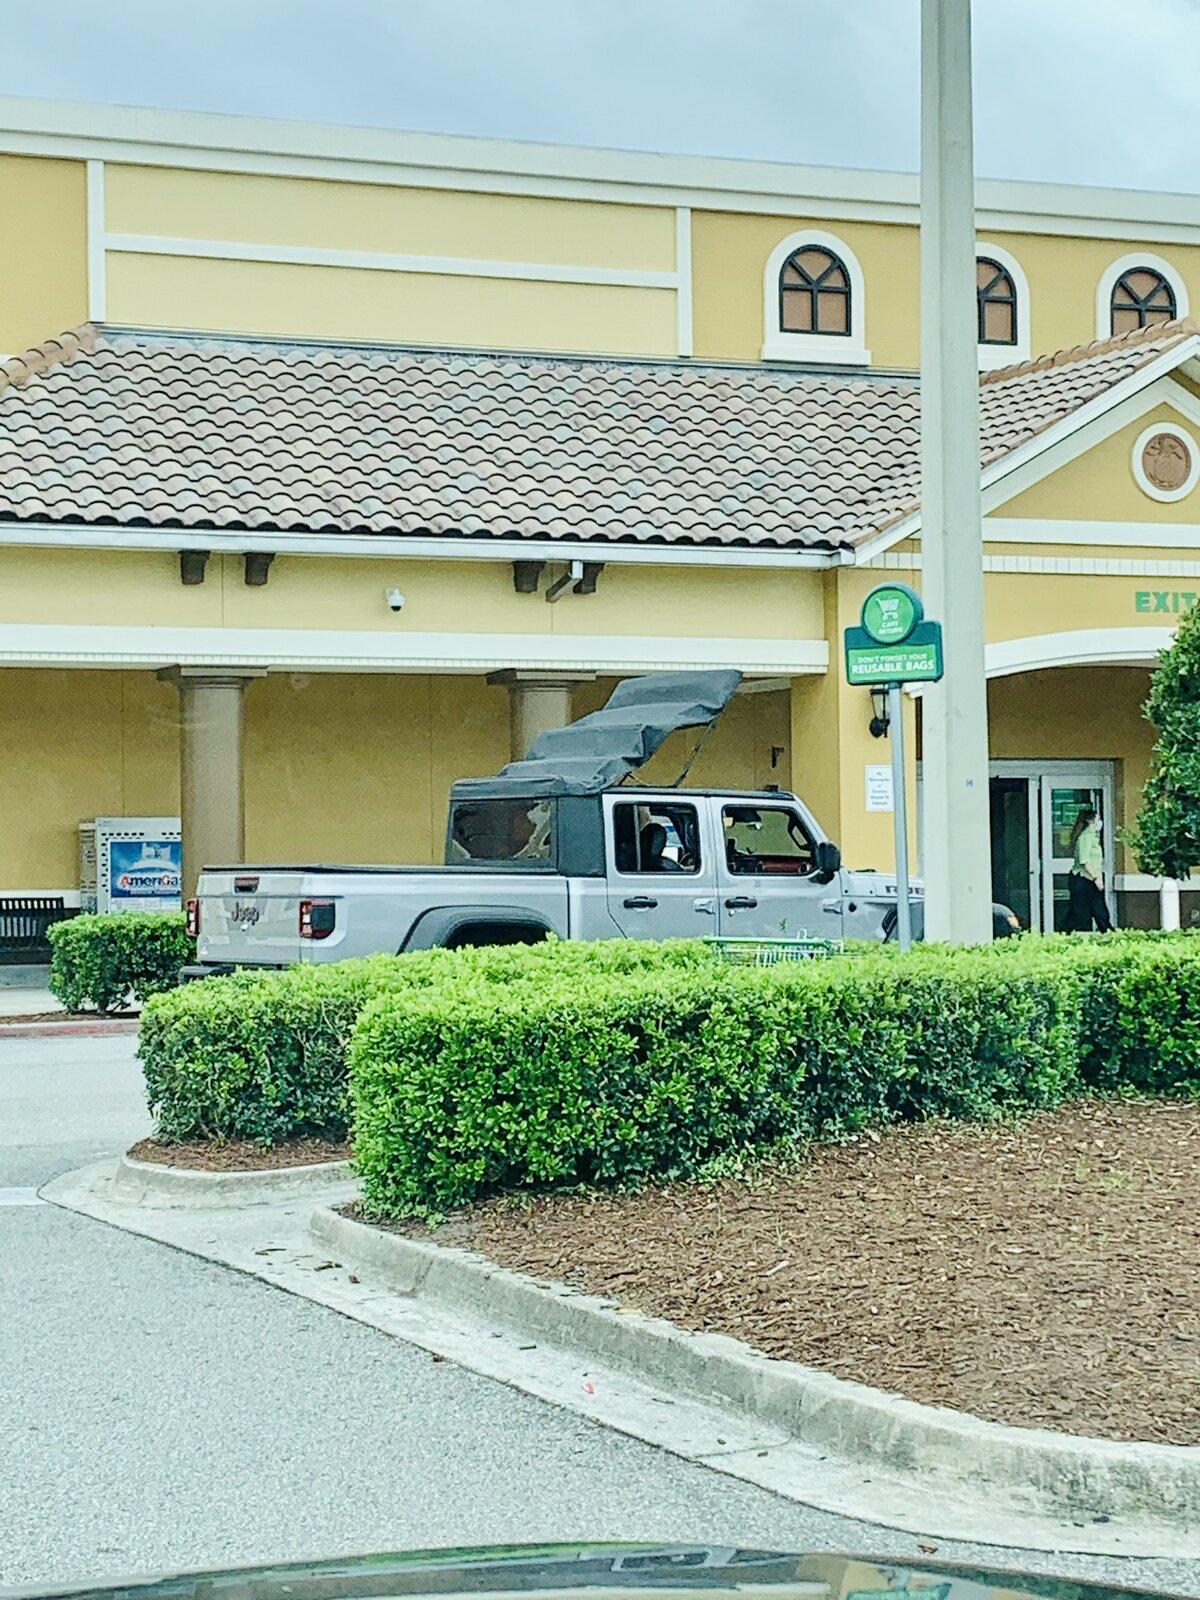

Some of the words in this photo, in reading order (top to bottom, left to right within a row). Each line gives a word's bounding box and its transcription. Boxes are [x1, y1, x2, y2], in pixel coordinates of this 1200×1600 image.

[1135, 591, 1197, 613] EXIT
[878, 627, 904, 635] RETURN
[881, 620, 899, 628] CART
[857, 656, 879, 664] DON'T
[880, 654, 907, 662] FORGET
[908, 653, 928, 661] YOUR
[851, 662, 904, 675] REUSABLE
[905, 660, 935, 671] BAGS
[121, 874, 181, 888] AmeriGa
[231, 901, 260, 926] Jeep
